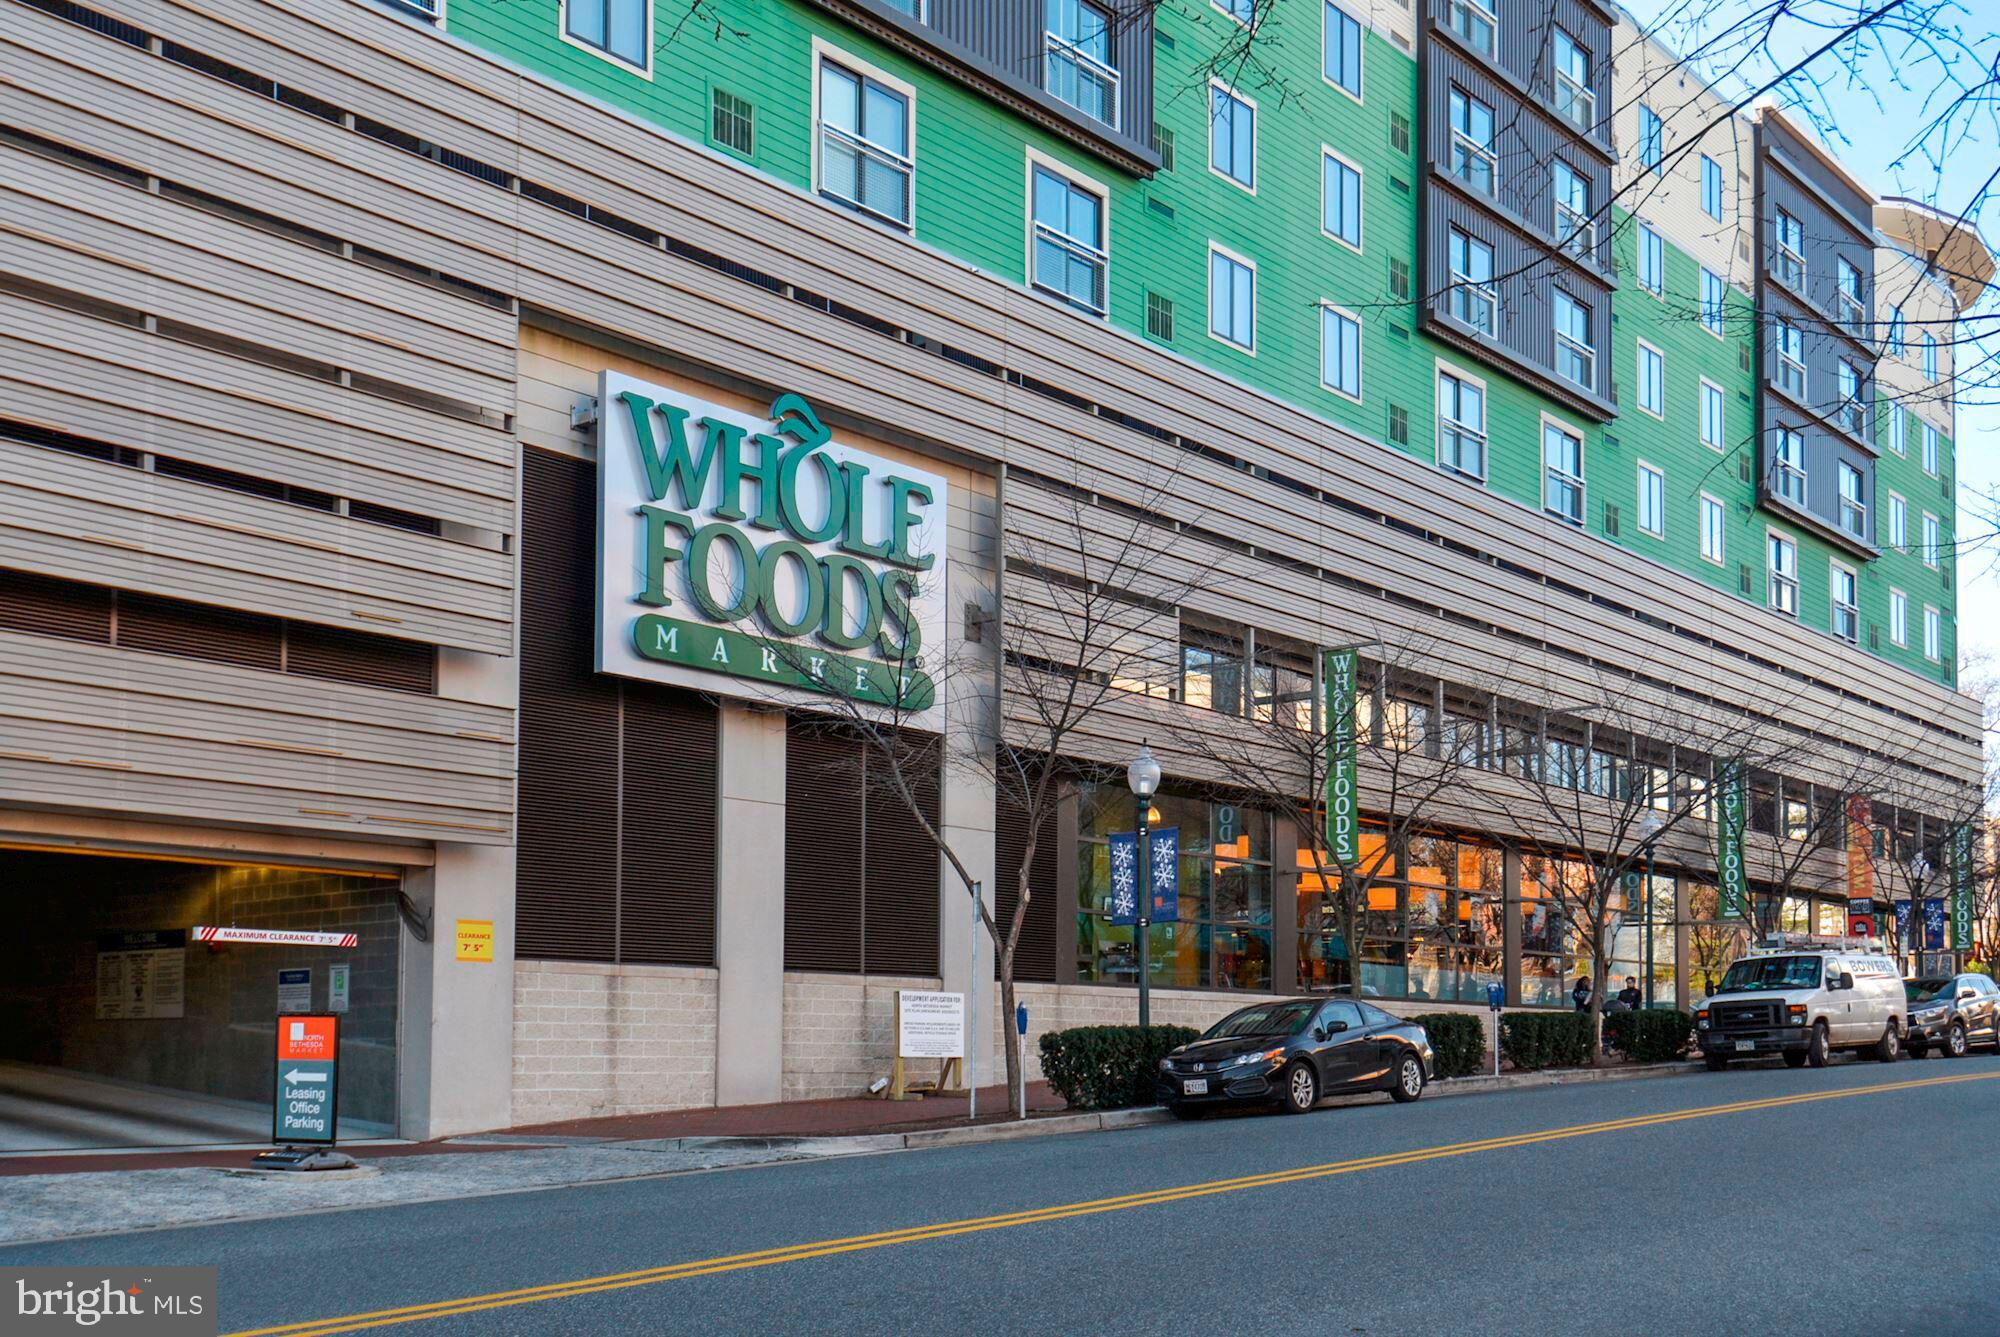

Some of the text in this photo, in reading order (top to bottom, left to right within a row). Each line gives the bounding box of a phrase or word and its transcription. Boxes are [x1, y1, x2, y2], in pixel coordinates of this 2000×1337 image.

[618, 391, 935, 571] WHOLE
[634, 505, 922, 661] FOODS
[655, 624, 912, 700] MARKET
[1332, 655, 1351, 754] WHOLE
[1335, 760, 1352, 854] FOODS
[223, 931, 267, 940] MAXIMUM
[269, 933, 315, 942] CLEARANCE
[1849, 960, 1894, 972] BOWERS
[285, 1087, 326, 1102] Leasing
[290, 1101, 320, 1114] Office
[285, 1116, 324, 1132] Parking
